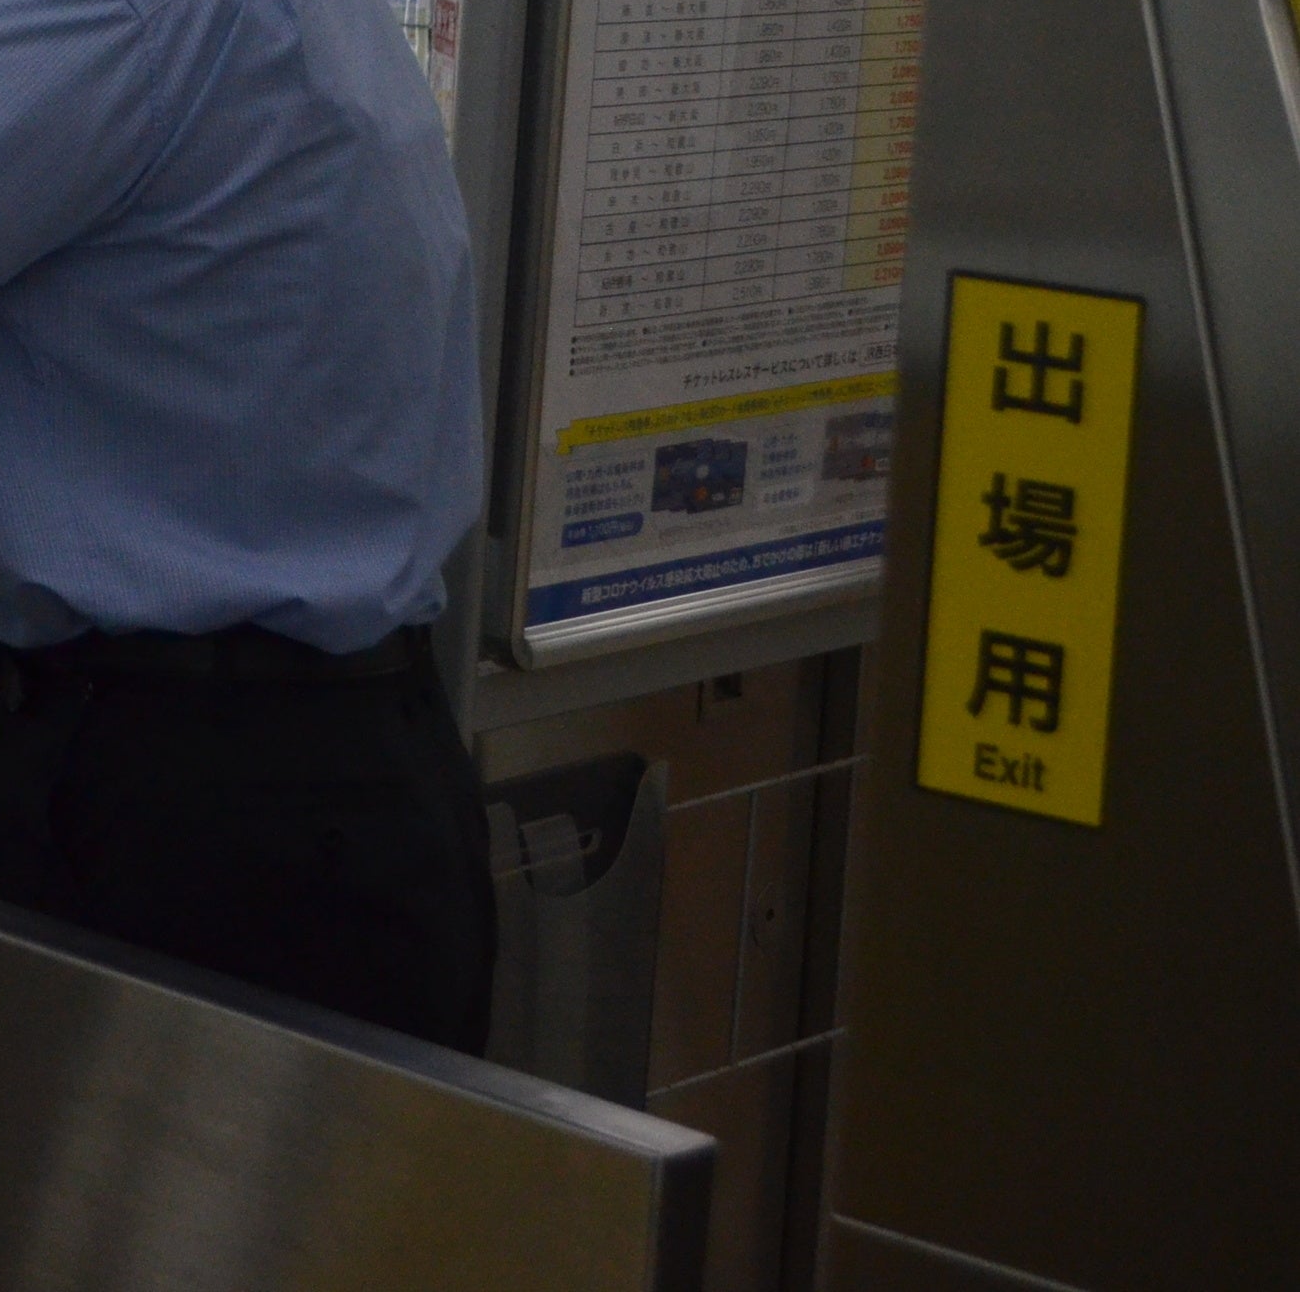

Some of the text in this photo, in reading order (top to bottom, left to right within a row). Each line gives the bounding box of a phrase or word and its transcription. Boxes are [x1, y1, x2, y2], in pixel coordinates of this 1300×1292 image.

[965, 319, 1086, 736] 出場用
[974, 742, 1047, 793] Exit
